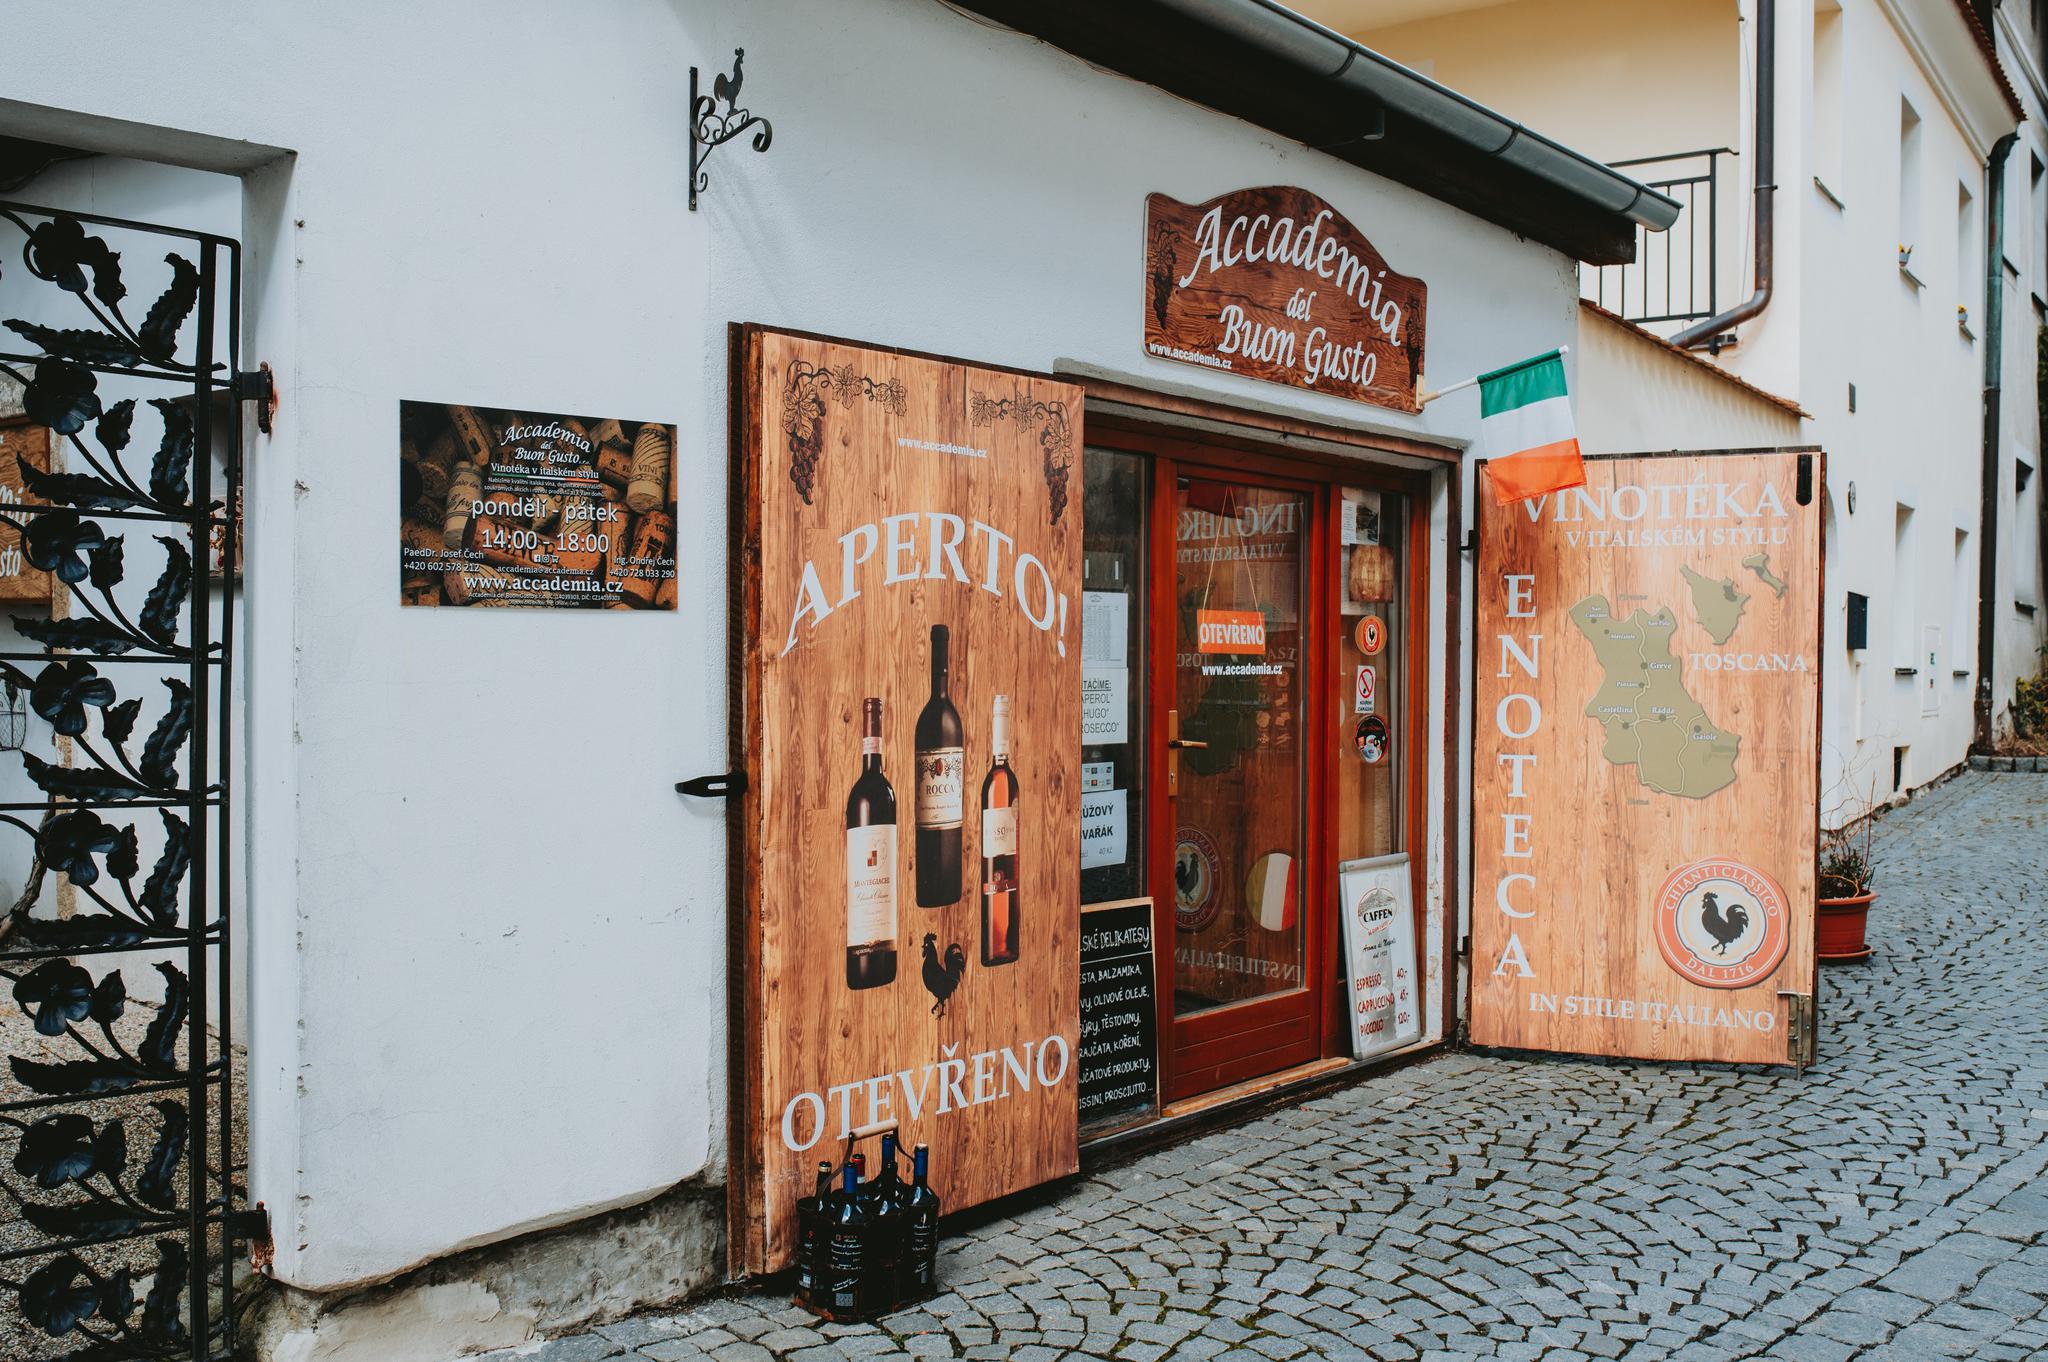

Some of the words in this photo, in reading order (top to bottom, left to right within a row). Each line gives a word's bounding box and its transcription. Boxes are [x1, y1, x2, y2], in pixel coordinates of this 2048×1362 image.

[1178, 205, 1402, 347] Accademia
[1286, 288, 1317, 322] del
[1217, 304, 1296, 369] Buon
[1303, 327, 1377, 386] Gusto
[1149, 342, 1233, 370] www.accademia.cz
[501, 421, 591, 453] Accademia
[540, 441, 552, 450] del
[897, 437, 988, 458] www.accademia.cz
[514, 447, 545, 461] Buon
[548, 449, 580, 464] Gusto
[490, 462, 530, 474] Vinotéka
[539, 466, 577, 477] italském
[577, 469, 599, 479] stylu
[1524, 472, 1788, 523] VINOTÉKA
[472, 497, 547, 520] pondělí
[565, 501, 618, 523] pátek
[482, 528, 538, 550] 14:00
[556, 532, 609, 553] 18:00
[1566, 531, 1584, 548] V
[1587, 525, 1706, 548] ITALSKÉM
[1712, 528, 1788, 545] STYLU
[403, 547, 437, 558] PaedDr.
[440, 549, 462, 559] Josef
[463, 548, 484, 559] Čech
[629, 556, 656, 567] Ondřej
[656, 555, 675, 566] Čech
[403, 561, 426, 571] +420
[427, 562, 444, 571] 602
[445, 563, 462, 572] 578
[463, 563, 480, 572] 212
[496, 565, 594, 576] accademia@accademia.cz
[609, 569, 628, 577] +420
[630, 569, 644, 577] 728
[645, 570, 659, 578] 033
[661, 570, 675, 578] 290
[463, 576, 624, 593] www.accademia.cz
[780, 512, 1068, 658] APERTO!
[1199, 618, 1265, 646] OTEVŘENO
[1201, 662, 1283, 676] www.accademia.cz
[1650, 662, 1673, 671] Greve
[1689, 653, 1808, 674] TOSCANA
[1598, 706, 1633, 714] Castellina
[1652, 706, 1675, 714] Radda
[1492, 574, 1544, 979] ENOTECA
[926, 783, 954, 796] ROCCA
[1081, 802, 1114, 819] ŮŽOVÝ
[1081, 824, 1114, 840] VAŘÁK
[1665, 866, 1717, 911] CHIANTI
[1721, 866, 1778, 917] CLASSICO
[1363, 907, 1393, 924] CAFFEN
[1080, 927, 1099, 951] SKÉ
[1100, 927, 1150, 949] DELIKATESY
[1098, 964, 1143, 981] BALZAMIKA,
[1686, 958, 1716, 978] DAL
[1722, 963, 1754, 979] 1716
[1356, 973, 1382, 992] ESPRESSO
[1093, 986, 1124, 1007] OLIVOVÉ
[1358, 992, 1395, 1014] CAPPUCCINO
[1529, 991, 1558, 1014] IN
[1564, 995, 1634, 1020] STILE
[1640, 1001, 1775, 1033] ITALIANO
[1359, 1018, 1384, 1037] PICCOLO
[1113, 1031, 1142, 1052] KOŘENÍ,
[1078, 1062, 1112, 1084] JČATOVÉ
[781, 1034, 1070, 1152] OTEVŘENO
[1104, 1081, 1147, 1103] PROSCIUTTO
